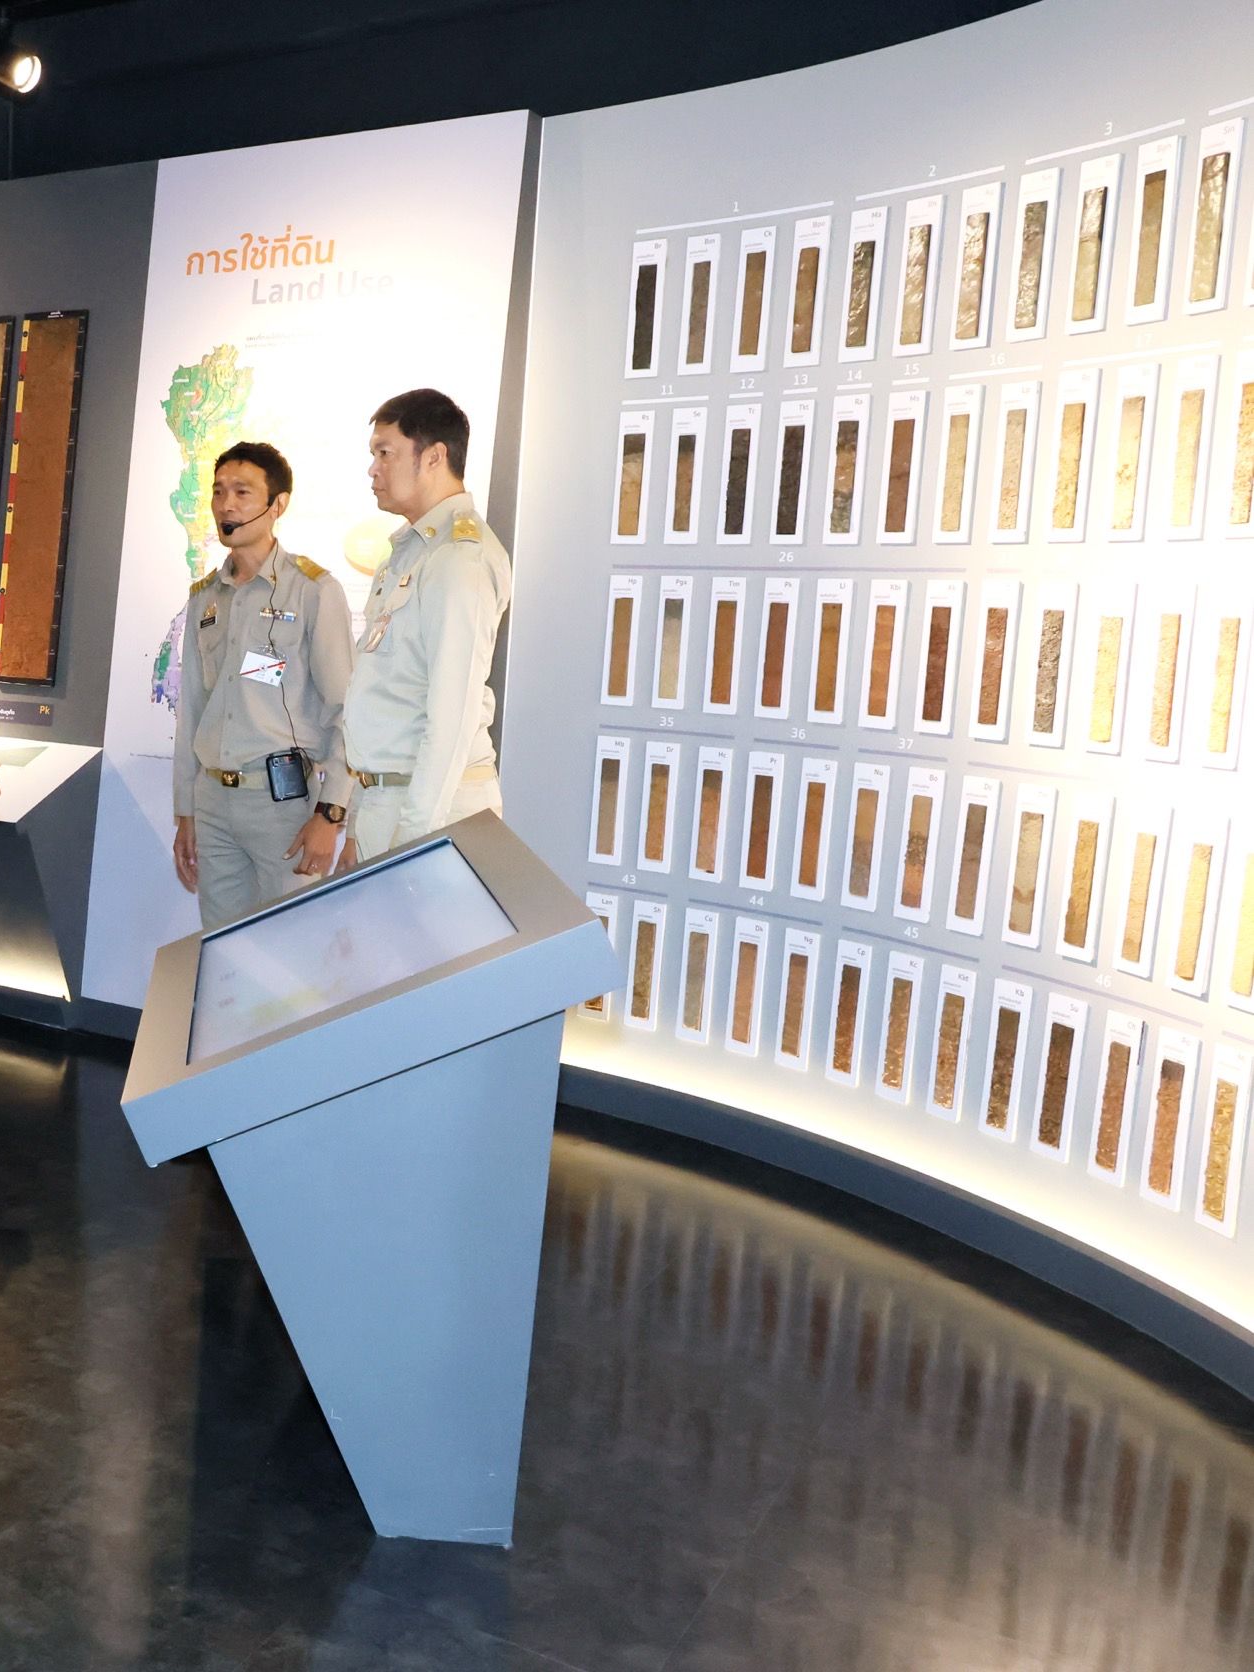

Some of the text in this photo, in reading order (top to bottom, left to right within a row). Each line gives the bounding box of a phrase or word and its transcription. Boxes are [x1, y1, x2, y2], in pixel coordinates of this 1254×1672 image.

[1104, 122, 1113, 136] 3
[928, 165, 936, 177] 2
[732, 201, 739, 212] 1
[186, 225, 335, 276] การใช้ที่ดิน
[251, 269, 394, 305] Land Use
[989, 353, 1005, 365] 16
[904, 363, 920, 375] 15
[793, 374, 808, 385] 13
[847, 370, 863, 381] 14
[740, 378, 754, 389] 12
[661, 384, 674, 395] 11
[778, 552, 794, 562] 26
[39, 705, 50, 715] Pk
[659, 716, 674, 727] 35
[791, 727, 806, 740] 36
[899, 738, 914, 749] 37
[622, 874, 636, 885] 43
[749, 895, 764, 906] 44
[904, 926, 919, 939] 45
[1096, 975, 1112, 988] 46
